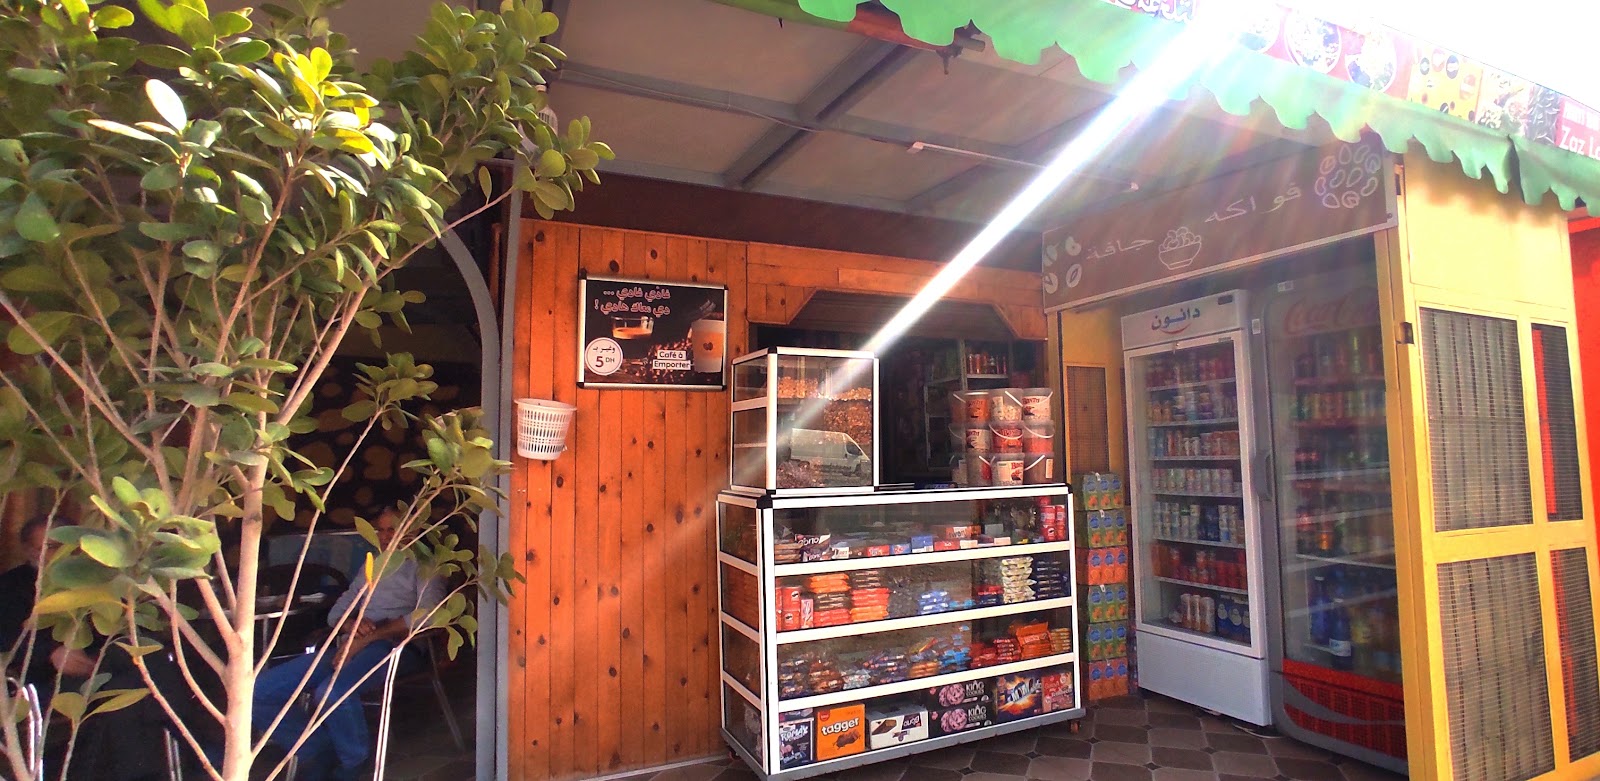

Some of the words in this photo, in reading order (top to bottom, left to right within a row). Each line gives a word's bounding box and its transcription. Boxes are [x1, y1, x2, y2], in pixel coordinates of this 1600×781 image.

[1559, 125, 1586, 155] Zaz
[659, 351, 677, 359] Café
[595, 356, 604, 368] 5
[654, 360, 689, 368] Emporter
[965, 679, 985, 692] KING
[967, 704, 987, 717] KING
[821, 717, 860, 736] tagger
